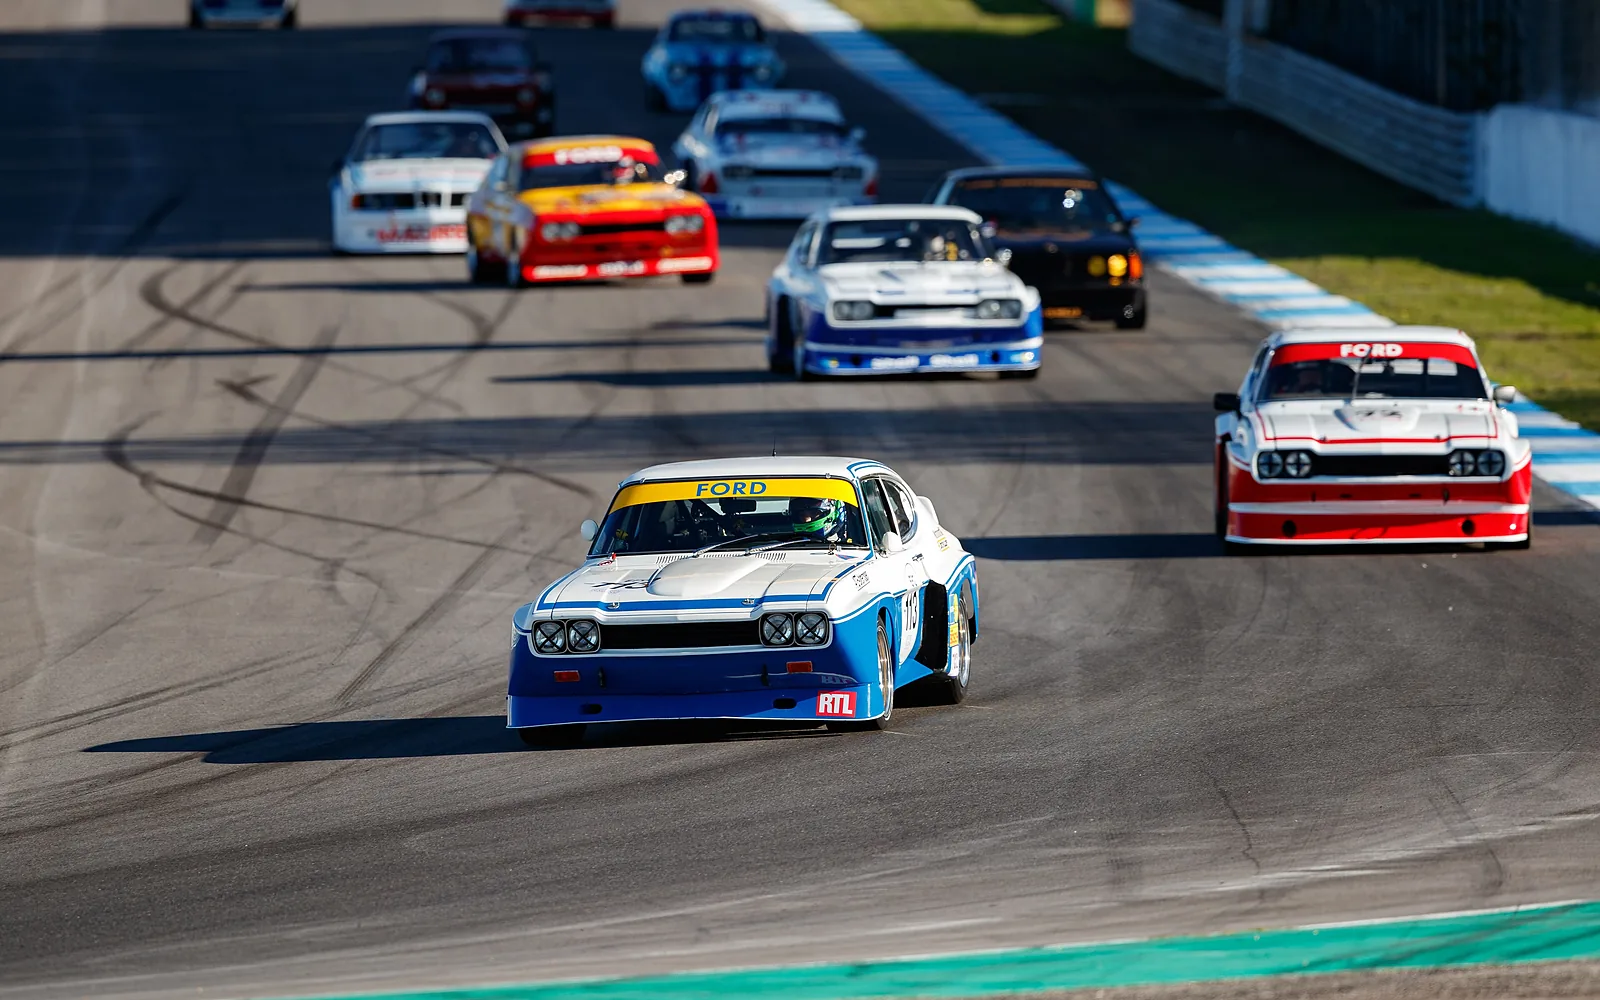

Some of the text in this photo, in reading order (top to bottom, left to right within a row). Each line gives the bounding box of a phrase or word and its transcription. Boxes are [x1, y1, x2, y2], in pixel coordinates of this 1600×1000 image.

[1341, 343, 1403, 357] FORD
[696, 481, 767, 496] FORD
[905, 591, 918, 631] 113
[818, 693, 853, 714] RTL
